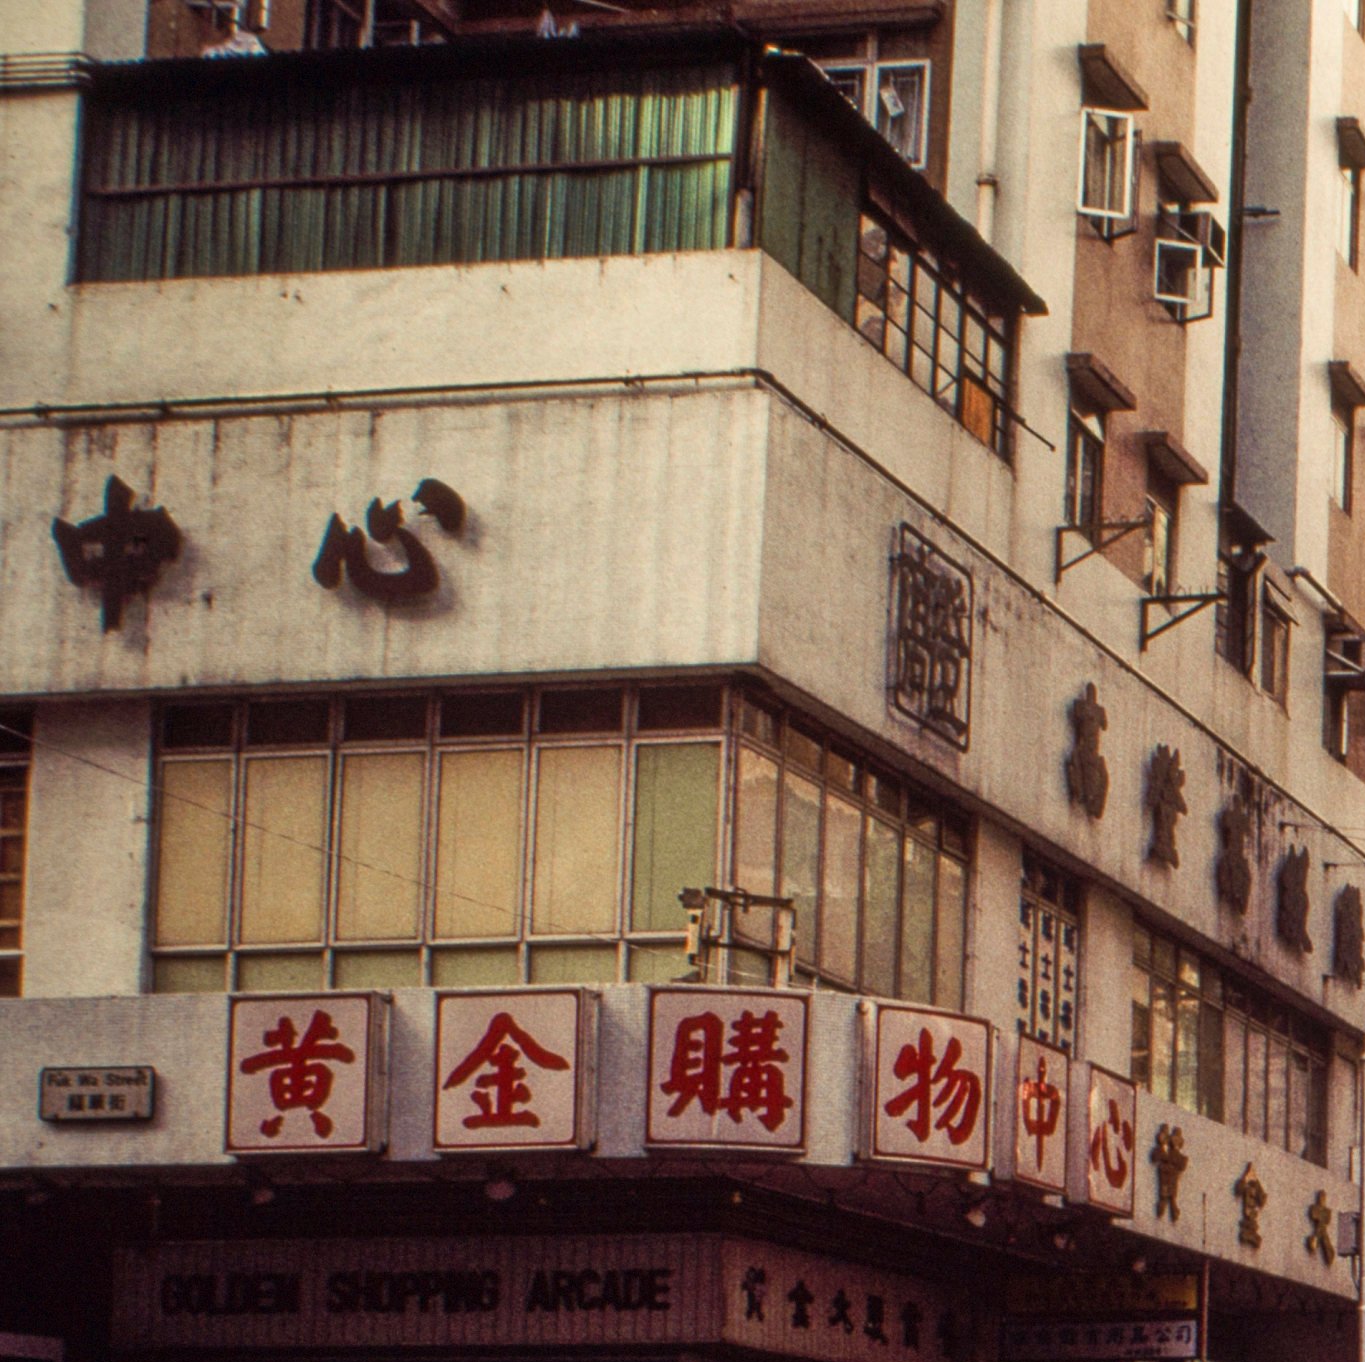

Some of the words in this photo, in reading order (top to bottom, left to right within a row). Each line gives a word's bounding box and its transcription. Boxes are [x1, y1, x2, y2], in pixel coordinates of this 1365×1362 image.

[77, 1073, 99, 1087] Wa
[104, 1070, 149, 1087] Street
[325, 1270, 499, 1314] SHOPPING
[526, 1267, 671, 1312] ARCADE
